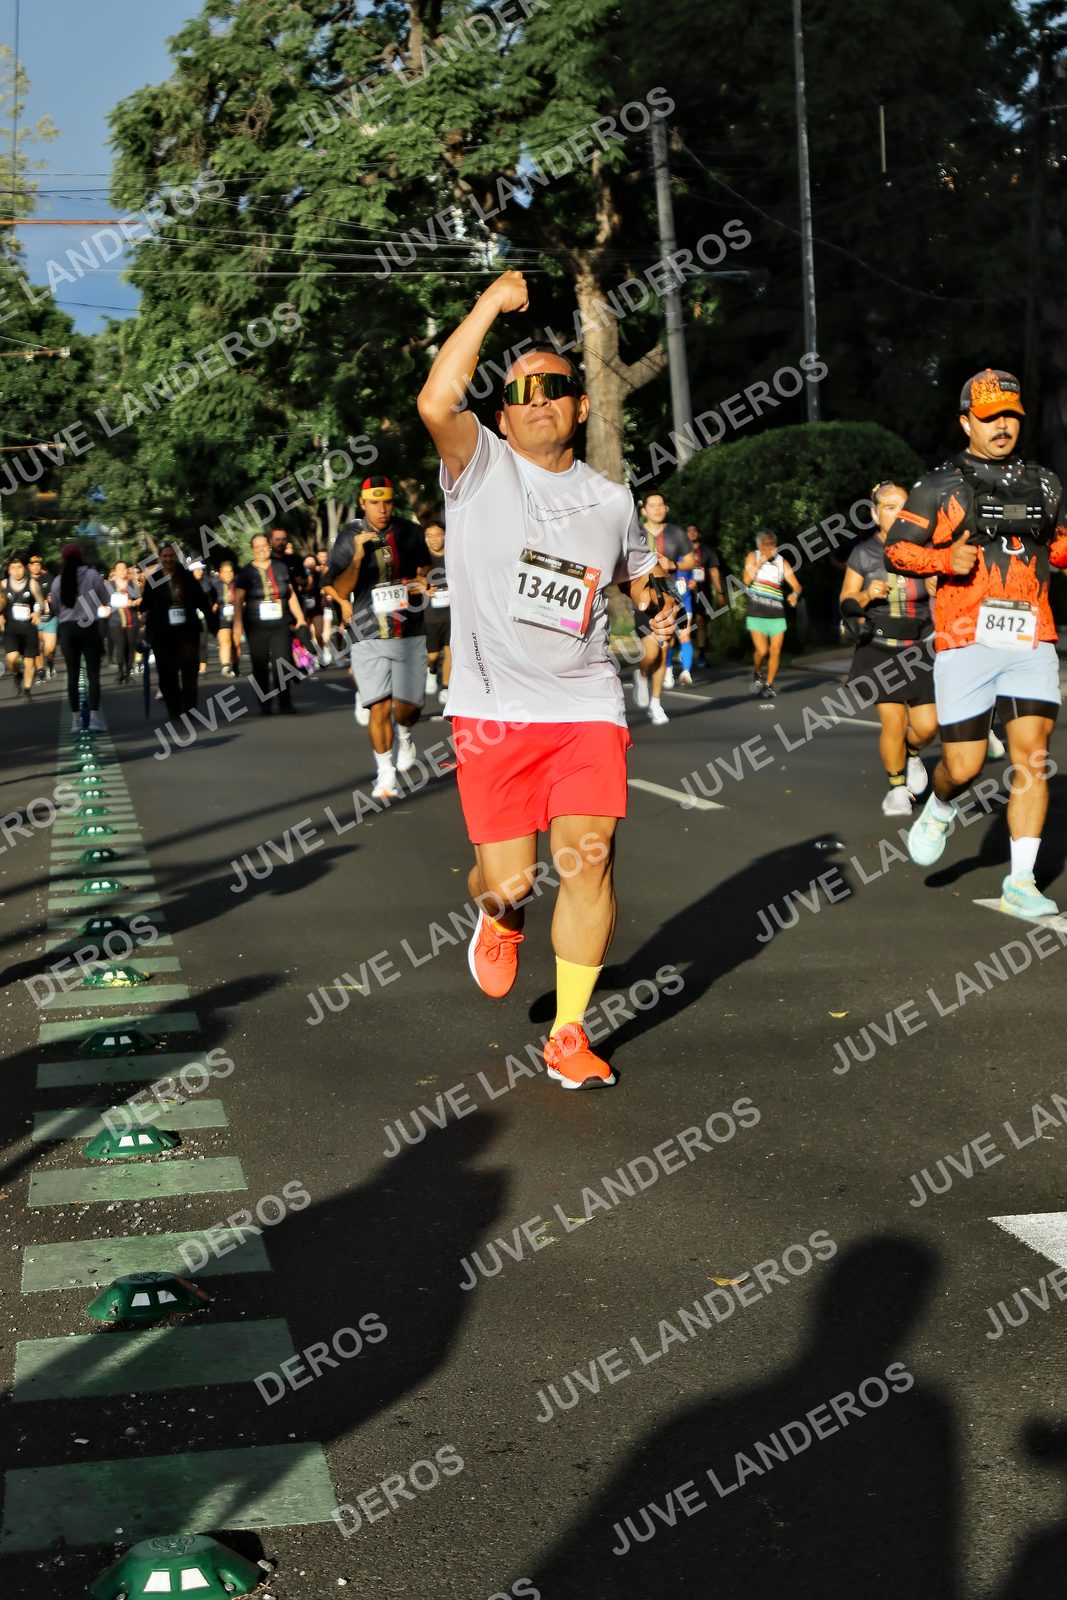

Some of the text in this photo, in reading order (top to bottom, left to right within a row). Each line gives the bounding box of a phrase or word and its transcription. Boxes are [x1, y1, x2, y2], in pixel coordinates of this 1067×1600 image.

[375, 588, 405, 602] 12187
[518, 572, 582, 611] 13440
[985, 614, 1026, 633] 8412
[471, 631, 491, 695] NIKE PRO COMBAT
